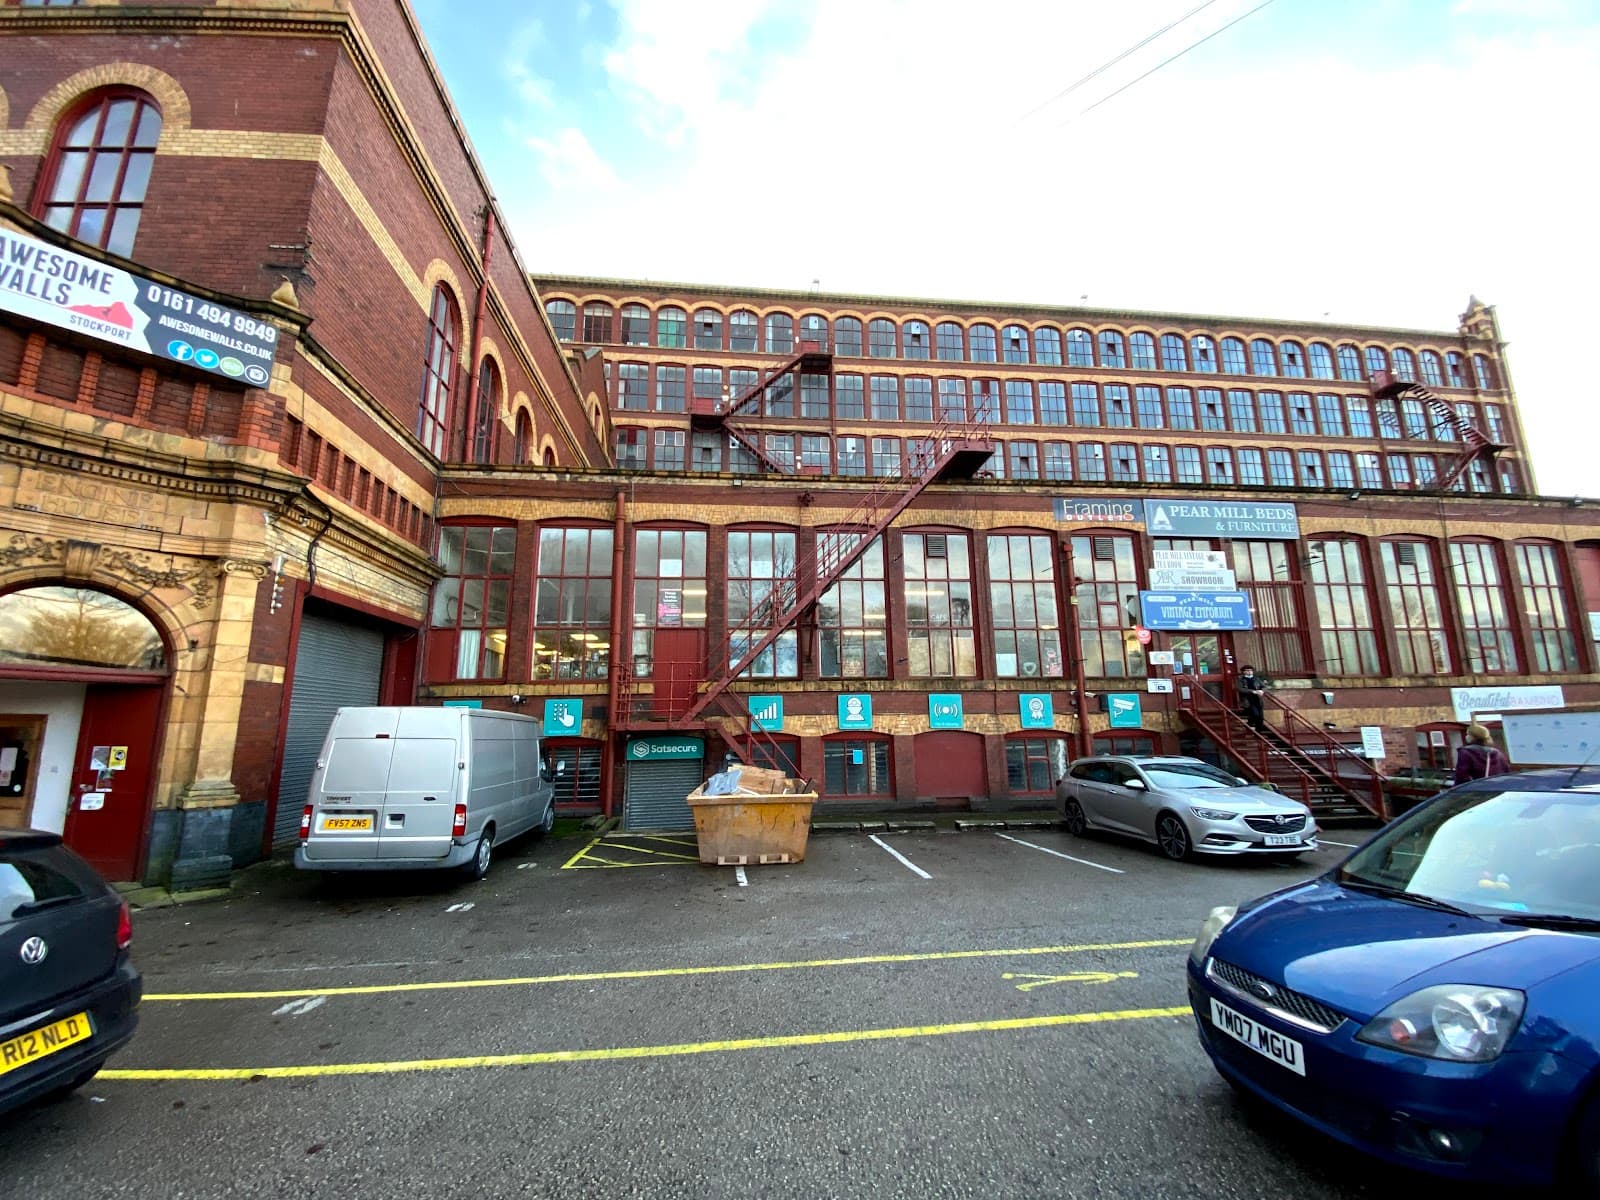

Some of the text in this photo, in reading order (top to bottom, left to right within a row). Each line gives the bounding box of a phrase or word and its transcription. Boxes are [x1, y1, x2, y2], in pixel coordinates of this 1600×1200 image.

[147, 285, 276, 343] 0161 494 9949
[69, 314, 132, 342] STOCKPORT
[158, 315, 273, 361] AWESOMEWALLS.CO.UK
[38, 471, 155, 509] ENGINE
[42, 493, 142, 527] HOUSE
[1063, 499, 1134, 521] Framing
[1168, 505, 1295, 521] PEAR MILL BEDS
[1215, 521, 1297, 534] & FURNITURE
[1180, 575, 1225, 585] SHOWROOM
[1160, 606, 1234, 619] VINTAGE EMPORIUM
[651, 743, 699, 754] Satsecure
[328, 818, 368, 828] FV57 ZNS
[2, 1019, 80, 1066] R12 NLD
[1215, 1003, 1296, 1066] YM07 MGU
